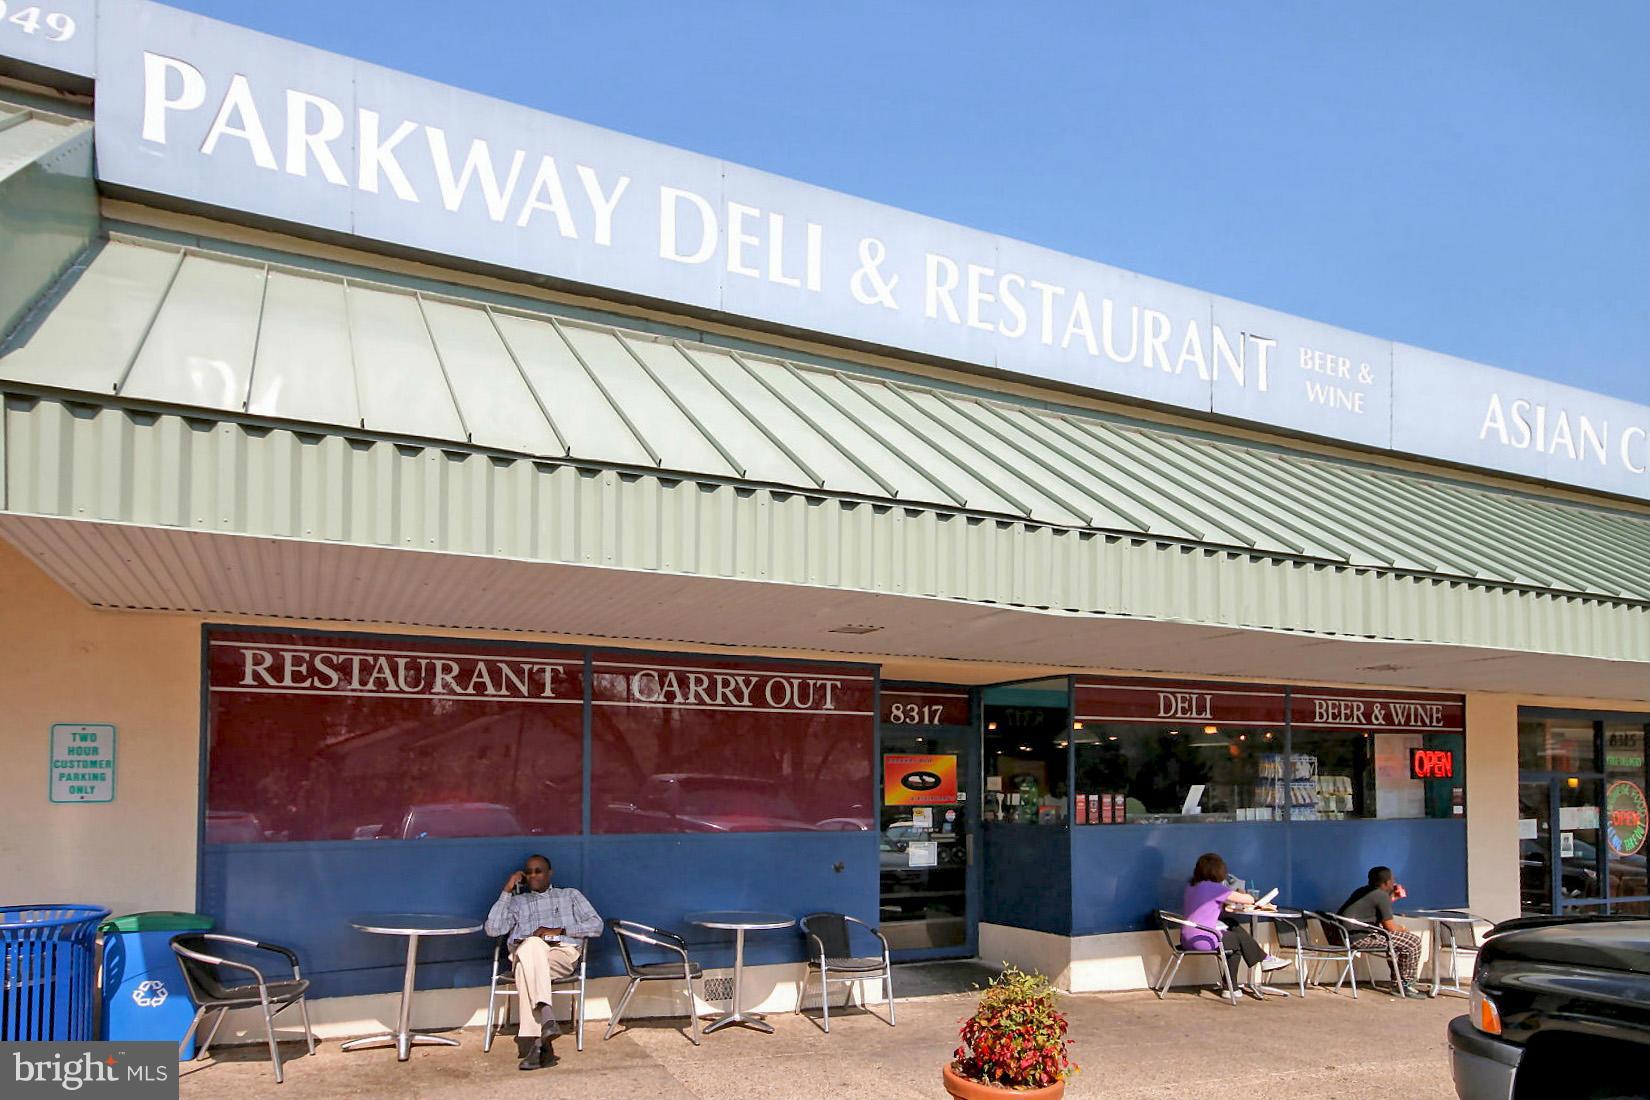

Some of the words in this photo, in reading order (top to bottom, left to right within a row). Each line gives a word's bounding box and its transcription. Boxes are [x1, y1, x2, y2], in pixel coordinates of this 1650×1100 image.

[0, 0, 76, 42] 49
[141, 50, 631, 247] PARKWAY
[659, 185, 823, 292] DELI
[850, 238, 899, 310] &
[924, 253, 1278, 393] RESTAURANT
[1299, 346, 1351, 381] BEER
[1358, 360, 1375, 386] &
[1305, 380, 1365, 414] WINE
[1480, 392, 1608, 465] ASIAN
[239, 648, 564, 698] RESTAURANT
[631, 670, 759, 707] CARRY
[765, 677, 842, 711] OUT
[889, 703, 944, 726] 8317
[1157, 692, 1214, 720] DELI
[1313, 699, 1366, 725] BEER
[1371, 702, 1386, 725] &
[1389, 703, 1444, 728] WINE
[67, 746, 99, 757] HOUR
[71, 733, 97, 743] TWO
[53, 760, 112, 769] CUSTOMER
[58, 773, 106, 782] PARKING
[1414, 750, 1453, 778] OPEN
[69, 786, 96, 795] ONLY
